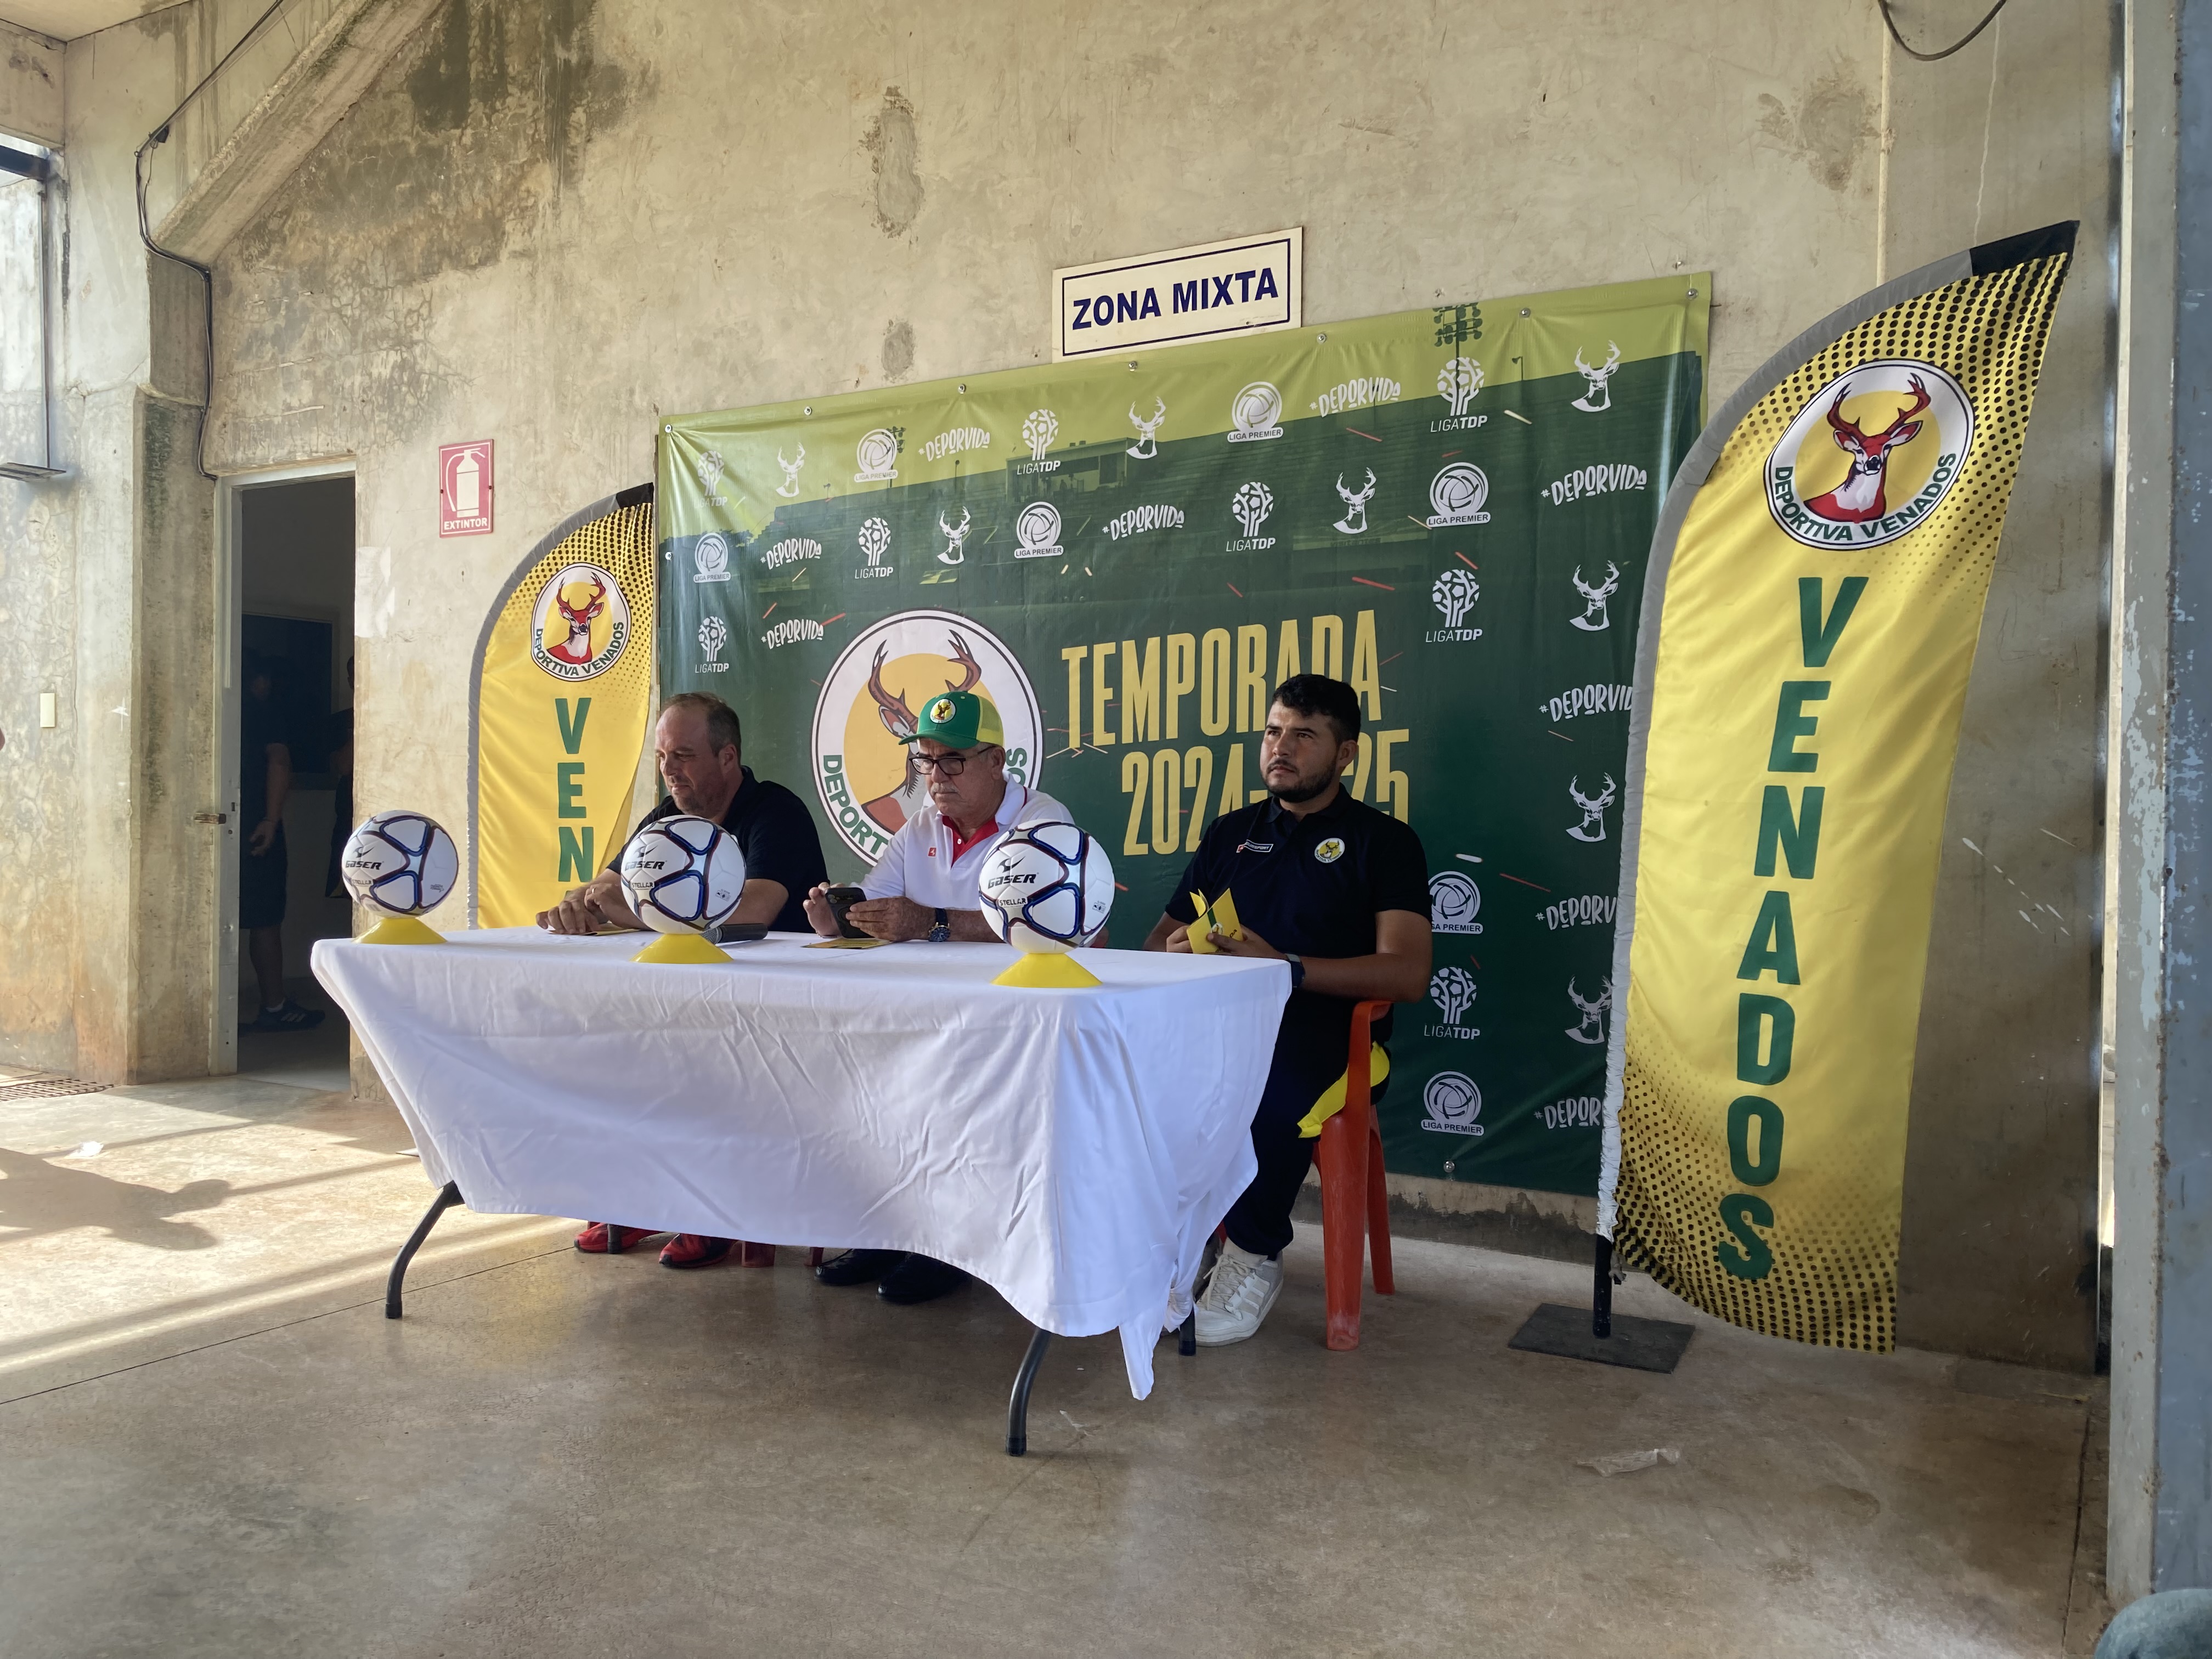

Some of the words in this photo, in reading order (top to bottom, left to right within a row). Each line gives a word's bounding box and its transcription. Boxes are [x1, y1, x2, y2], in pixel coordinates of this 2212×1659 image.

[1073, 287, 1161, 330] ZONA
[1173, 267, 1278, 314] MIXTA
[1309, 377, 1401, 417] #DEPORVIDA
[918, 427, 990, 461] #DEPORVIDA
[1229, 432, 1247, 441] LIGA
[1249, 429, 1282, 439] PREMIER
[1541, 464, 1647, 506] #DEPORVIDA
[1775, 466, 1853, 541] DEPORTIVA
[1860, 453, 1957, 539] VENADOS
[444, 517, 487, 530] EXTINTOR
[1102, 504, 1184, 541] #DEPORVIDA
[1428, 517, 1448, 526] LIGA
[1450, 514, 1488, 523] PREMIER
[760, 538, 822, 569] #DEPORVIDA
[534, 628, 579, 676] DEPORTIVA
[581, 622, 624, 674] VENADOS
[761, 618, 823, 649] #DEPORVIDA
[1539, 684, 1633, 722] #DEPORVID
[555, 697, 594, 887] VEN
[823, 755, 889, 855] DEPORT
[1122, 729, 1409, 855] 2024-25
[999, 897, 1027, 906] STELLAR
[1536, 895, 1617, 930] #DEPORV
[1443, 924, 1481, 932] PREMIER
[1718, 577, 1869, 1280] VENADOS
[1444, 1124, 1482, 1134] PREMIER
[1533, 1097, 1601, 1129] #DEPOR
